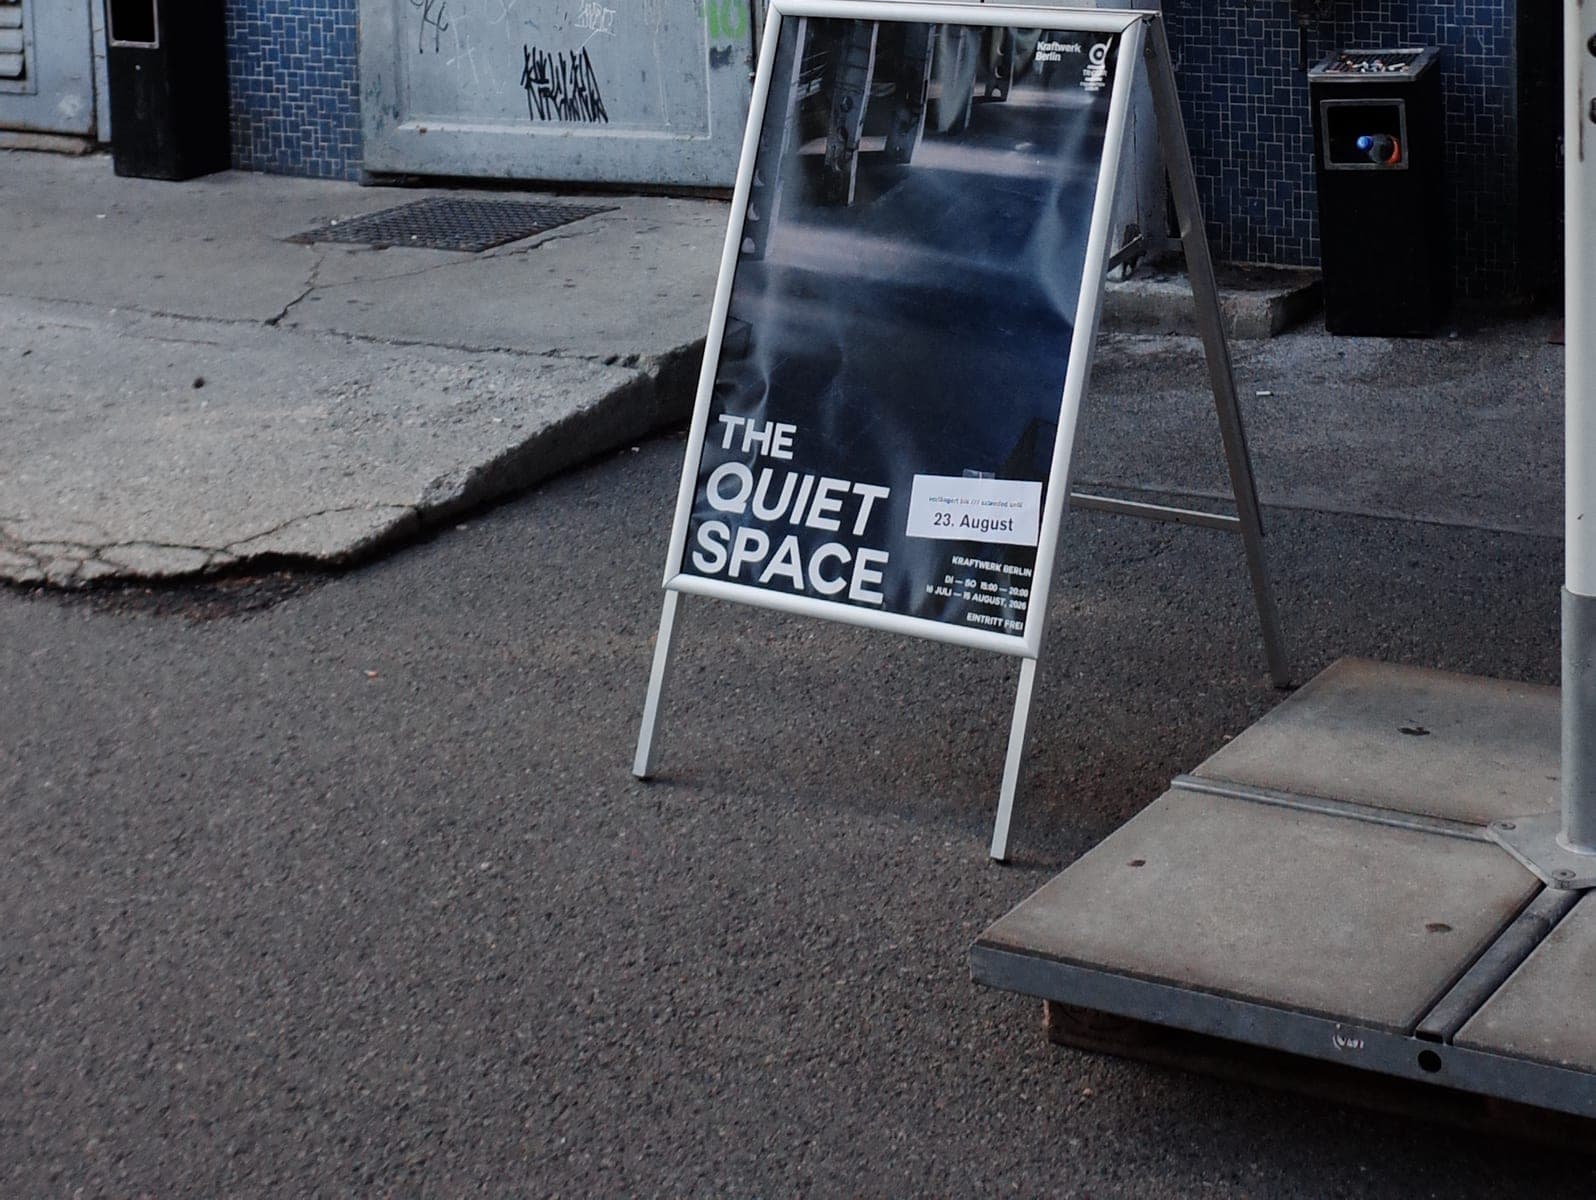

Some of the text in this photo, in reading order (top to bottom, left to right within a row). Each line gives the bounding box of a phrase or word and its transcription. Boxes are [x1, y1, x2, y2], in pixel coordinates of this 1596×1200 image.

[1035, 51, 1061, 61] Berlin
[1037, 41, 1081, 52] Kraftwerk
[718, 414, 797, 460] THE
[706, 461, 890, 536] QUIET
[933, 512, 1013, 532] 23. August
[692, 520, 889, 605] SPACE
[952, 555, 1032, 577] KRAFTWERK BERLIN
[945, 575, 954, 585] DI
[934, 586, 952, 597] JULI
[972, 594, 1007, 609] AUGUST,
[967, 612, 1024, 631] EINTRITT FREI
